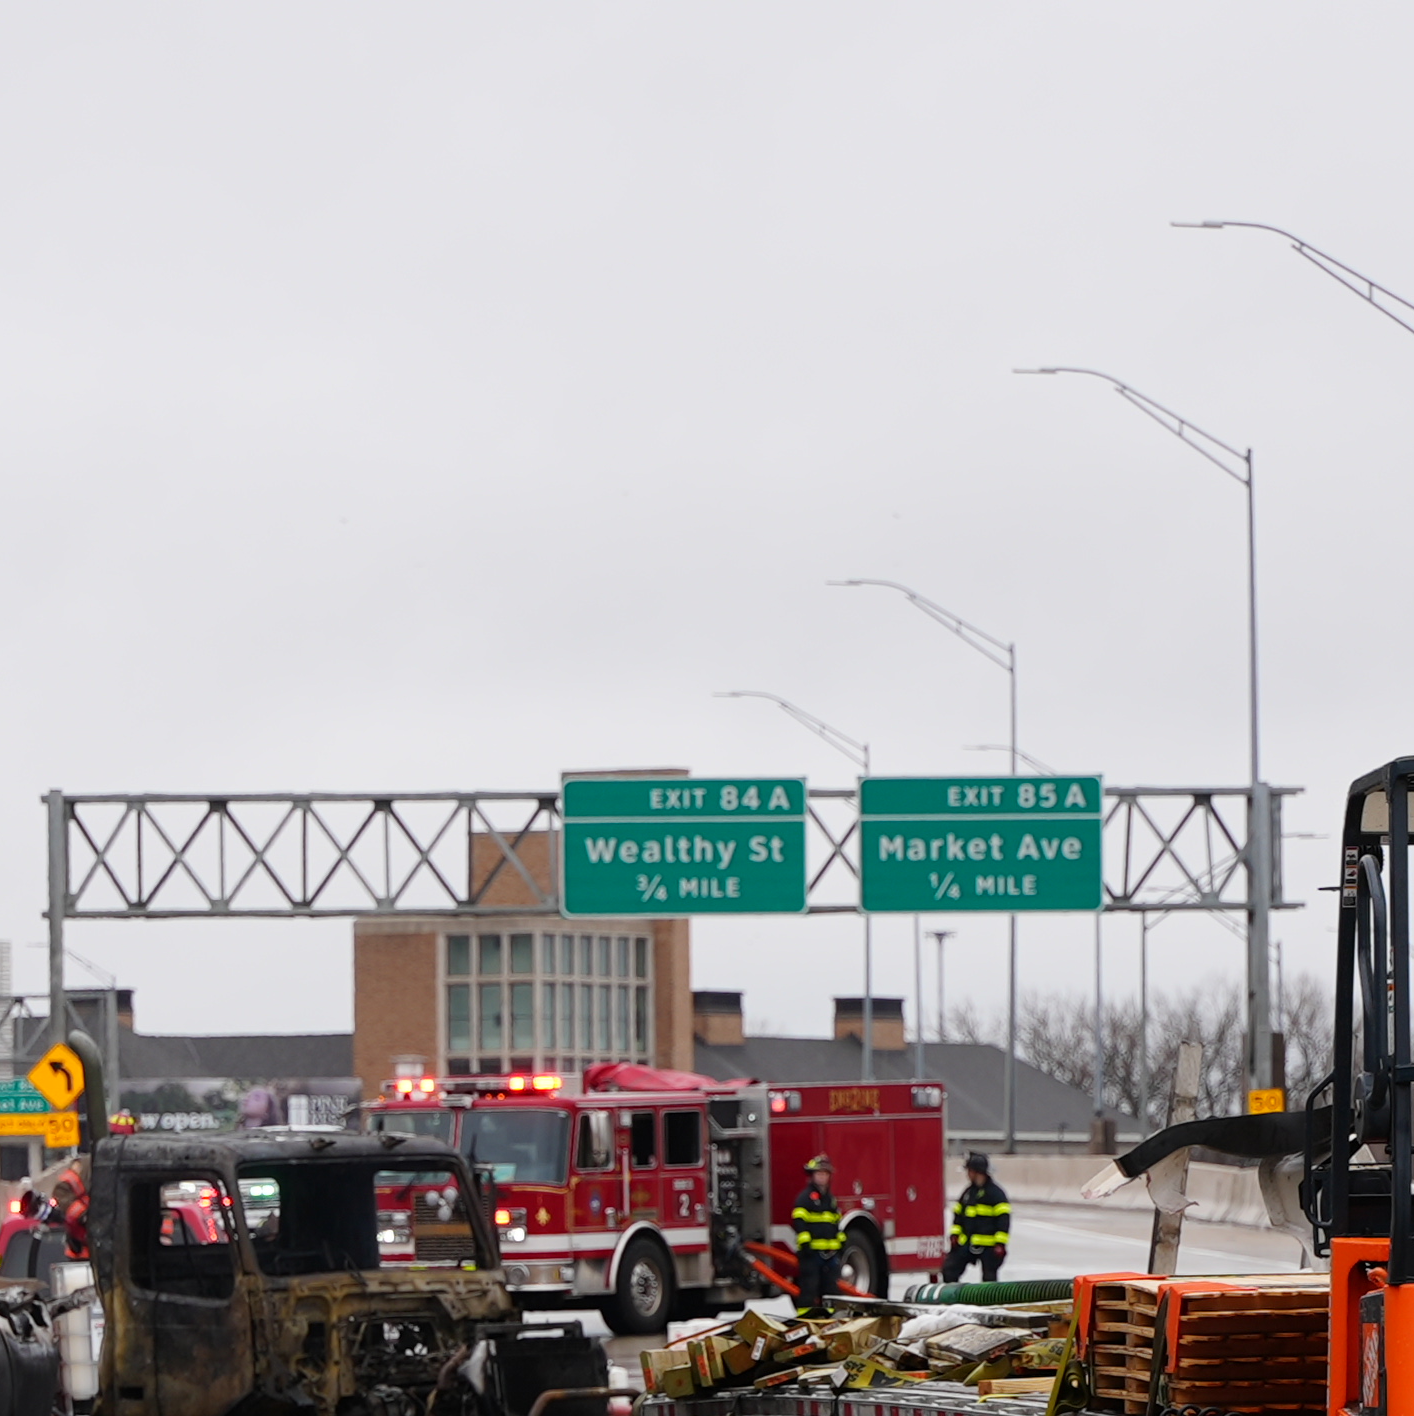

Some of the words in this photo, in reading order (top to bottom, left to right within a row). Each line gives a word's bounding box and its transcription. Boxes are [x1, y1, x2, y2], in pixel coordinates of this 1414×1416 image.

[649, 788, 707, 809] EXIT
[719, 785, 761, 810] 84
[767, 785, 790, 810] A
[947, 786, 1005, 807] EXIT
[1016, 783, 1057, 808] 85
[1063, 783, 1087, 808] A
[584, 835, 736, 870] Wealthy
[747, 835, 784, 863] St
[878, 833, 1004, 861] Market
[1016, 834, 1083, 860] Ave
[678, 877, 741, 898] MILE
[975, 875, 1037, 896] MILE
[160, 1110, 220, 1133] open.
[679, 1193, 690, 1217] 2
